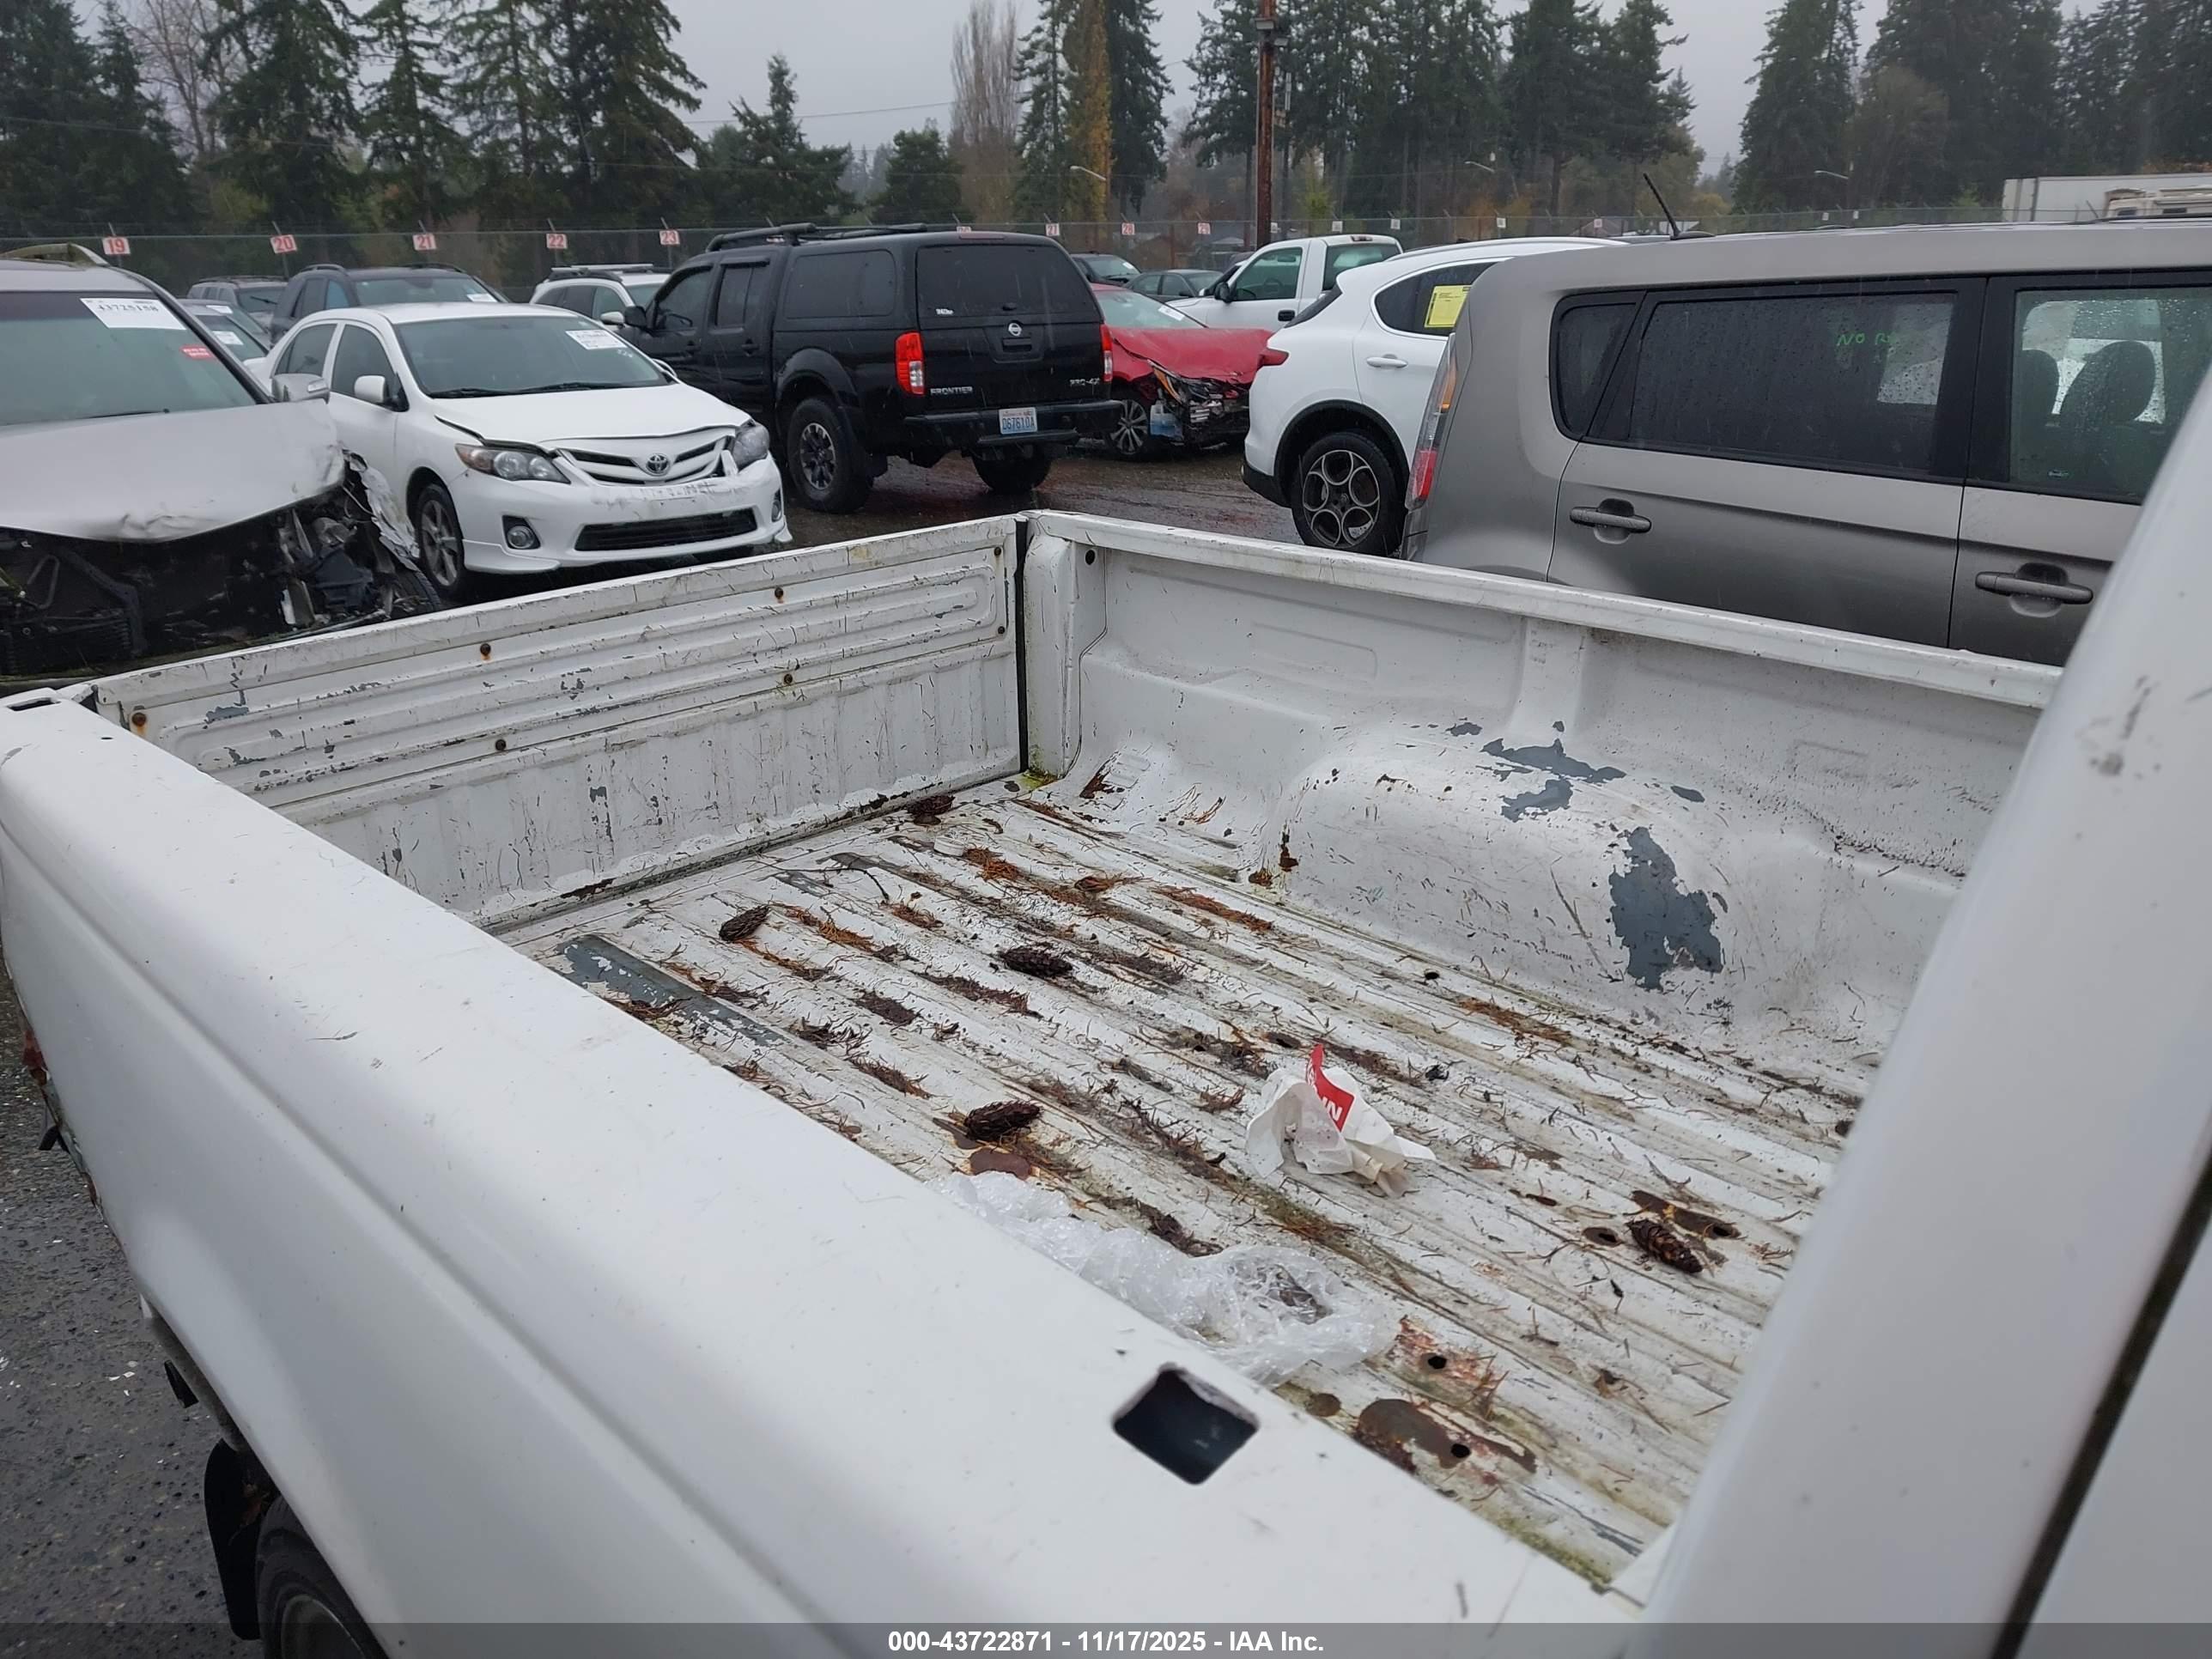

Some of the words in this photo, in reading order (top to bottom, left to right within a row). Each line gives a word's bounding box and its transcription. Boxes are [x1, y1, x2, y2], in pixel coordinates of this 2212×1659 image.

[275, 236, 293, 251] 20
[417, 235, 433, 248] 21
[549, 234, 564, 247] 22
[661, 231, 677, 244] 23
[108, 239, 125, 253] 19
[930, 386, 973, 395] FRONTIER
